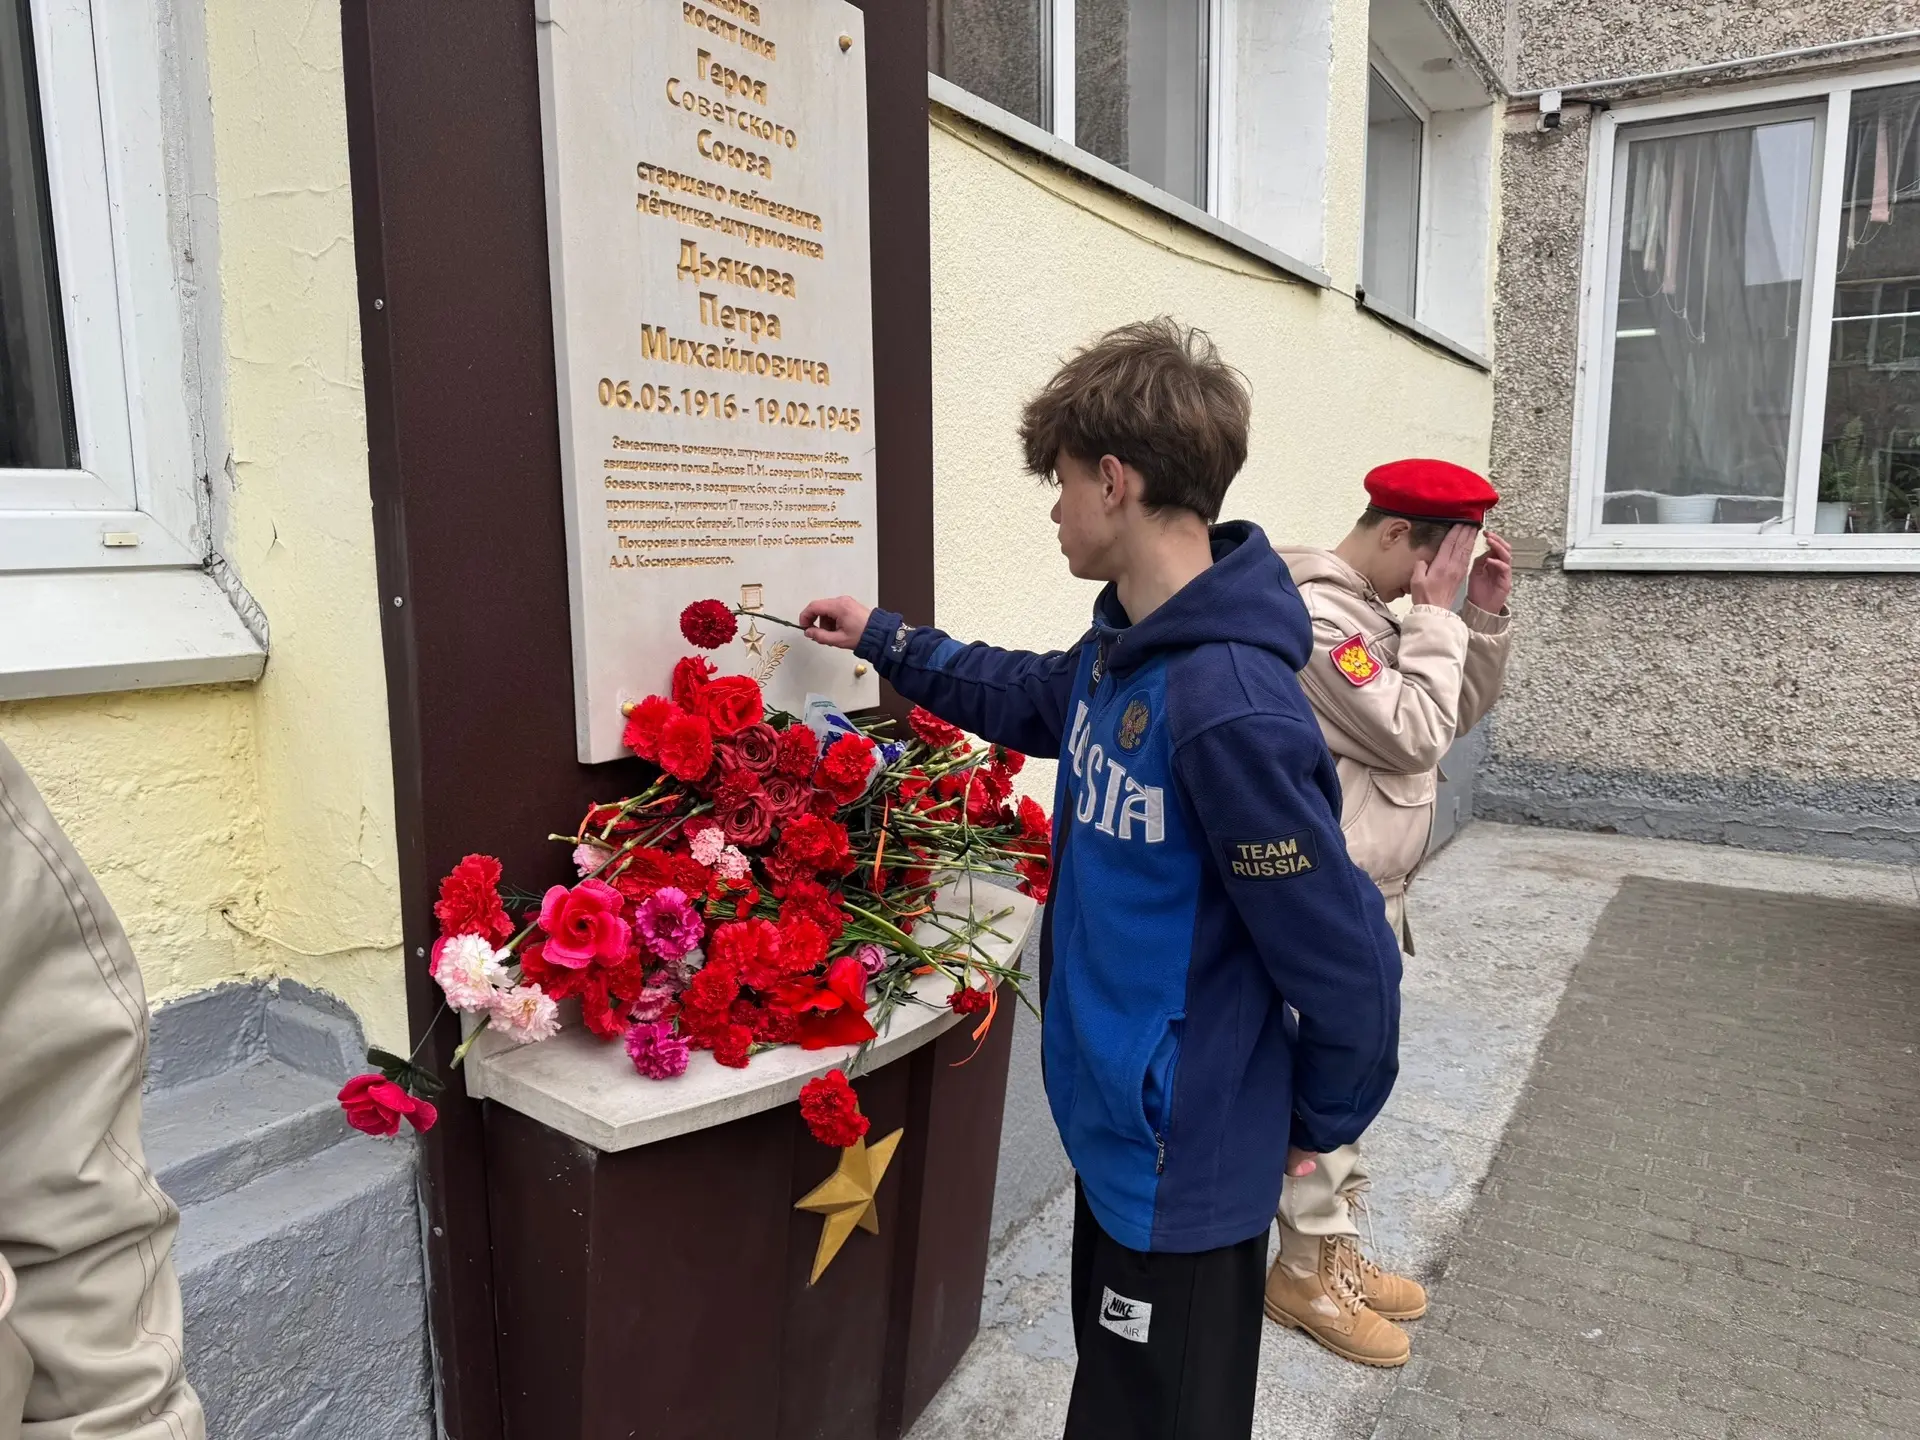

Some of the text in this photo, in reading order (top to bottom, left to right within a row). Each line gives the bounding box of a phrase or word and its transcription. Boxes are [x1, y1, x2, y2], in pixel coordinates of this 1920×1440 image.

[683, 1, 776, 61] носит имя
[697, 47, 767, 105] Героя
[666, 77, 797, 151] Советского
[696, 128, 772, 180] Союза
[636, 161, 823, 232] старшего лейтенанта
[636, 189, 824, 260] лётчика-штурмовика
[677, 238, 796, 300] Дьякова
[699, 291, 781, 344] Петра
[641, 323, 830, 387] Михайловича
[598, 377, 737, 421] 06.05.1916
[754, 397, 861, 433] 19.02.1945
[612, 435, 680, 454] Заместитель
[737, 448, 775, 462] штурман
[603, 459, 679, 473] авиационного
[681, 463, 709, 474] полка
[710, 461, 745, 476] Дьяков
[769, 468, 809, 480] совершил
[604, 476, 647, 491] боевых
[703, 483, 756, 496] воздушных
[756, 482, 777, 496] боях
[778, 483, 798, 496] сбил
[674, 500, 728, 515] уничтожил
[607, 516, 694, 532] артиллерийских
[737, 517, 763, 529] Погиб
[771, 517, 789, 529] бою
[618, 535, 679, 551] Похоронен
[757, 534, 782, 548] Героя
[783, 533, 829, 546] Советского
[830, 533, 854, 545] Союза
[609, 555, 634, 569] А.А.
[1237, 838, 1298, 860] TEAM
[1231, 854, 1312, 876] RUSSIA
[1110, 1297, 1135, 1317] NIKE
[1123, 1325, 1140, 1338] AIR
